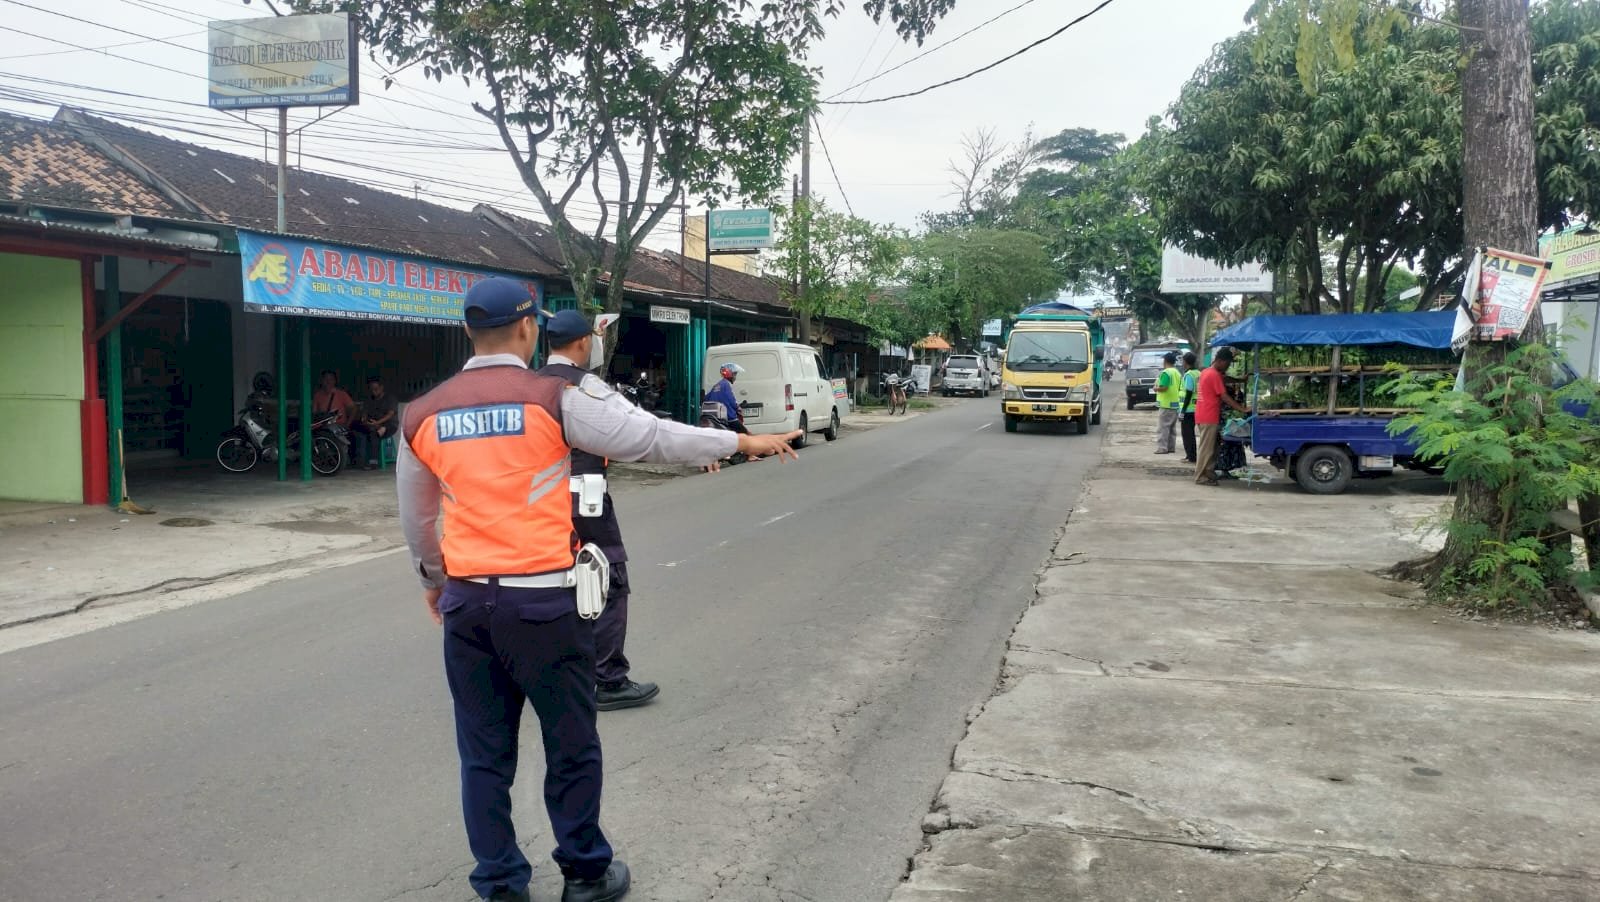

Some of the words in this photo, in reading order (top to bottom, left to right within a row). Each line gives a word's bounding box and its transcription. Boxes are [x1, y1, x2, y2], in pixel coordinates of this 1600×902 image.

[213, 45, 256, 66] ABADI
[258, 39, 345, 65] ELEKTRONIK
[298, 246, 397, 286] ABADI
[273, 306, 304, 314] JATINOM
[439, 409, 522, 439] DISHUB
